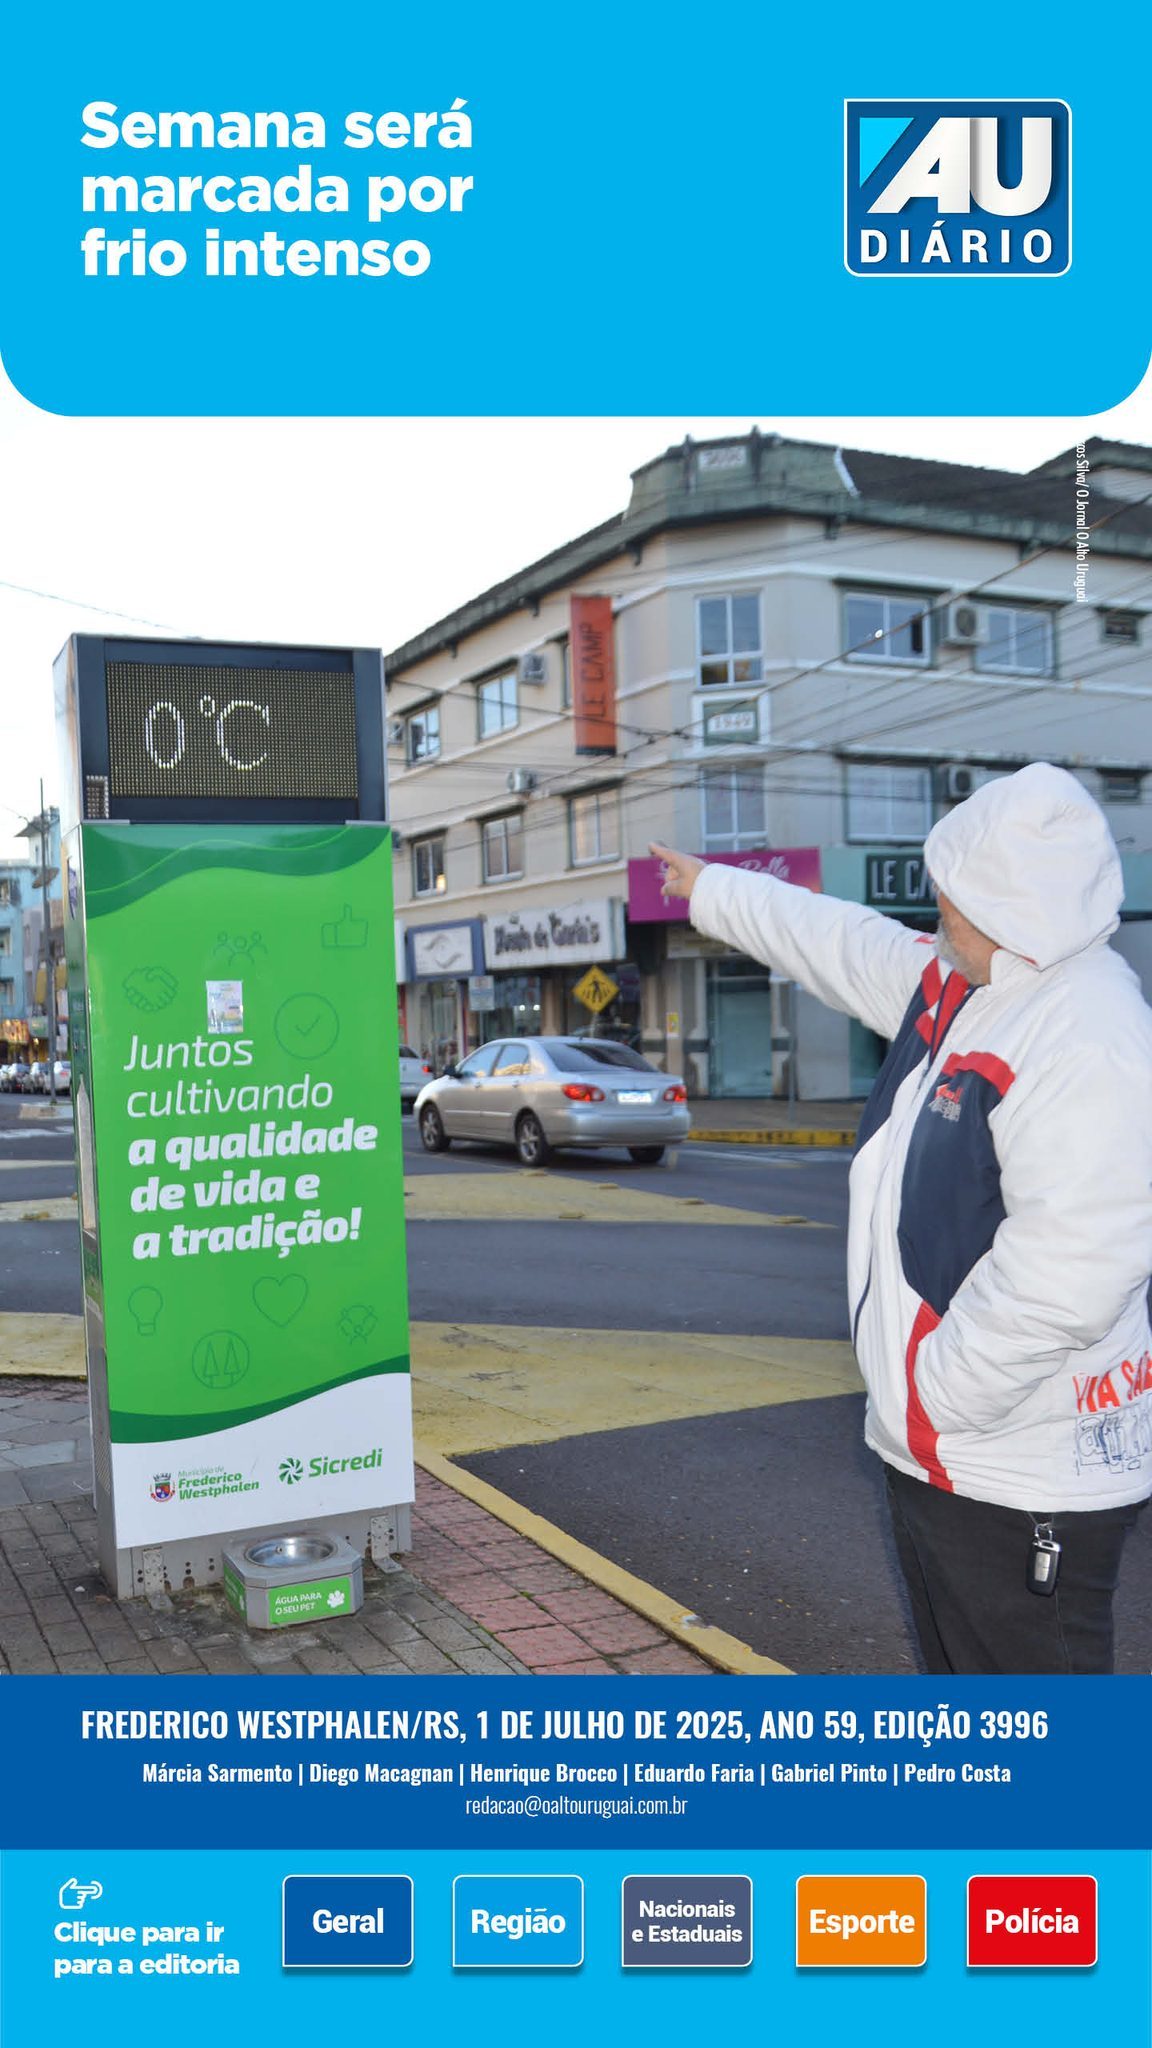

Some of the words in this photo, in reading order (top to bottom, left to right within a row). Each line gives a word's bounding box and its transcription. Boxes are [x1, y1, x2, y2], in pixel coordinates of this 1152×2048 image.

[872, 860, 897, 899] LE
[123, 1035, 255, 1071] Juntos
[127, 1074, 333, 1118] cultivando
[129, 1138, 157, 1166] a
[165, 1117, 378, 1171] qualidade
[131, 1176, 187, 1212] de
[194, 1169, 287, 1208] vida
[294, 1174, 321, 1201] e
[133, 1232, 161, 1260] a
[168, 1207, 362, 1259] tradição!
[178, 1472, 243, 1488] Frederico
[308, 1447, 384, 1478] Sicredi
[179, 1481, 260, 1500] Westphalen
[275, 1606, 282, 1615] O
[283, 1604, 299, 1614] SEU
[300, 1592, 322, 1602] PARA
